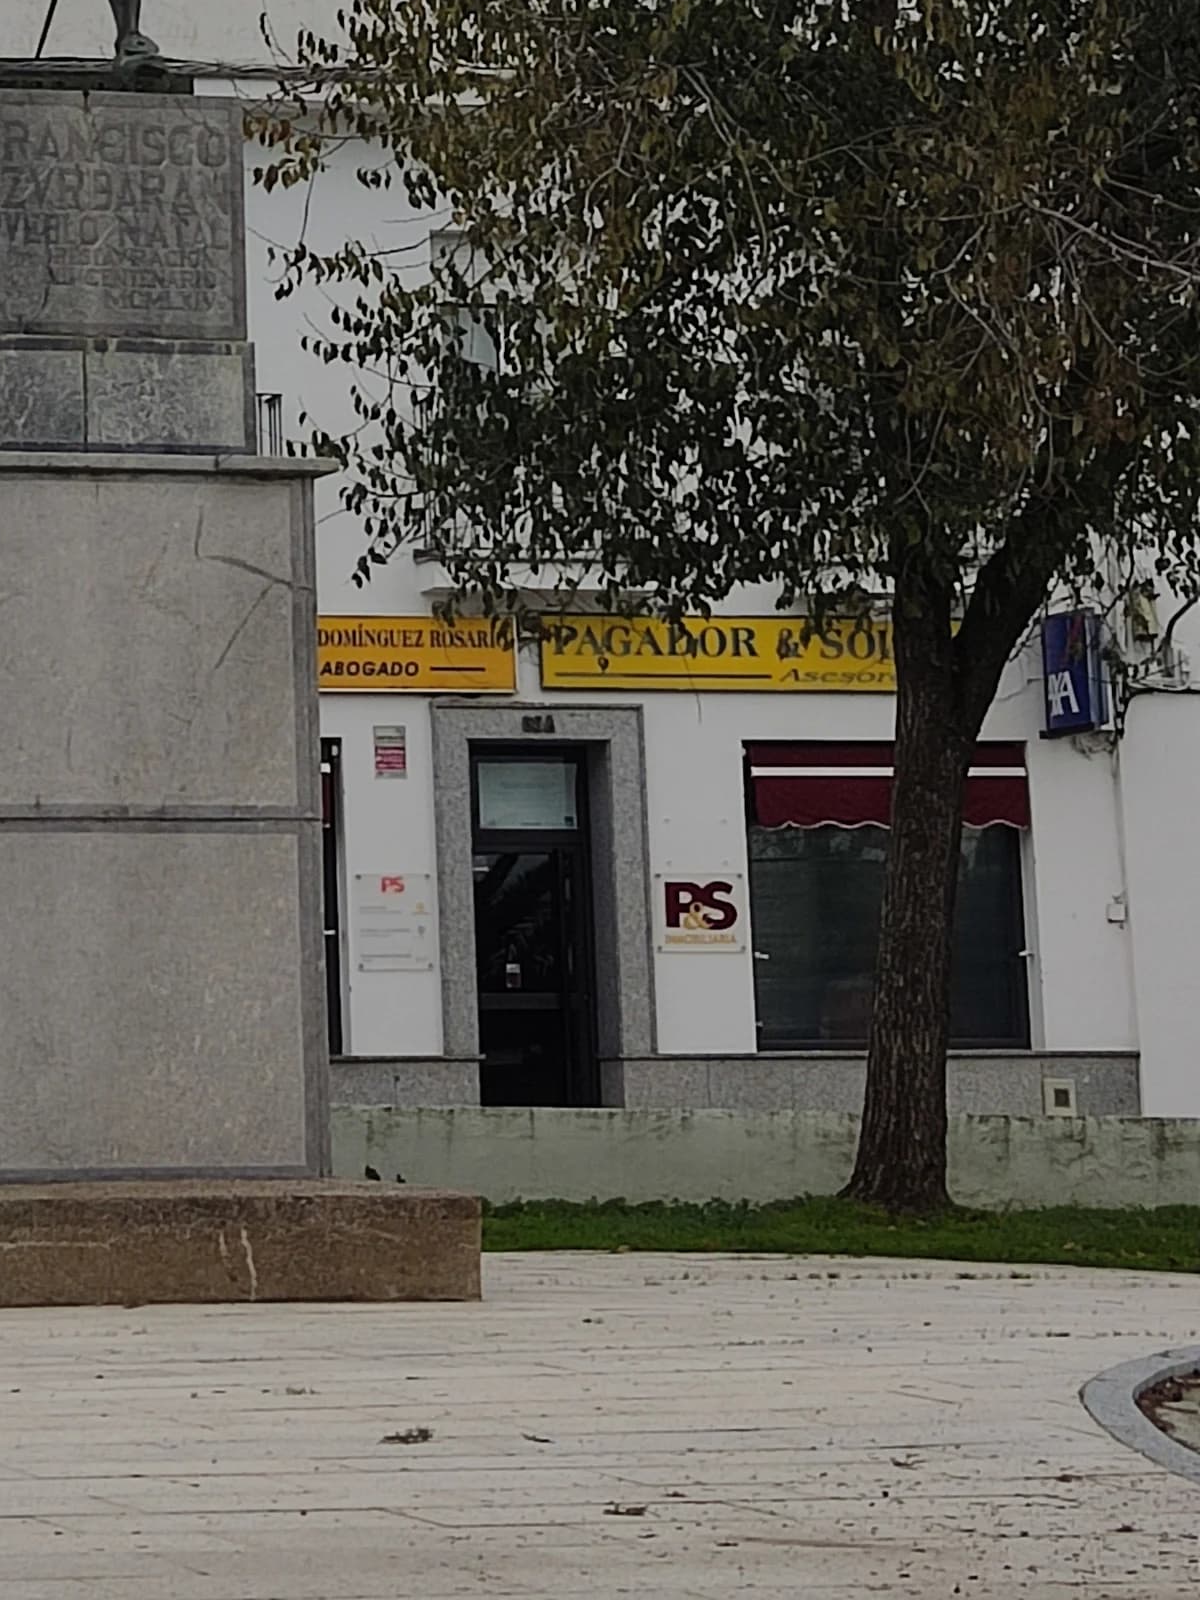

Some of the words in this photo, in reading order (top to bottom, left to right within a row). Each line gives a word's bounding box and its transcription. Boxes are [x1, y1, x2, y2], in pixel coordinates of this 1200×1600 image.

[112, 215, 229, 252] NATAL
[317, 624, 425, 649] DOMÍNGUEZ
[552, 624, 760, 659] PAGADOR
[319, 660, 420, 677] ABOGADO
